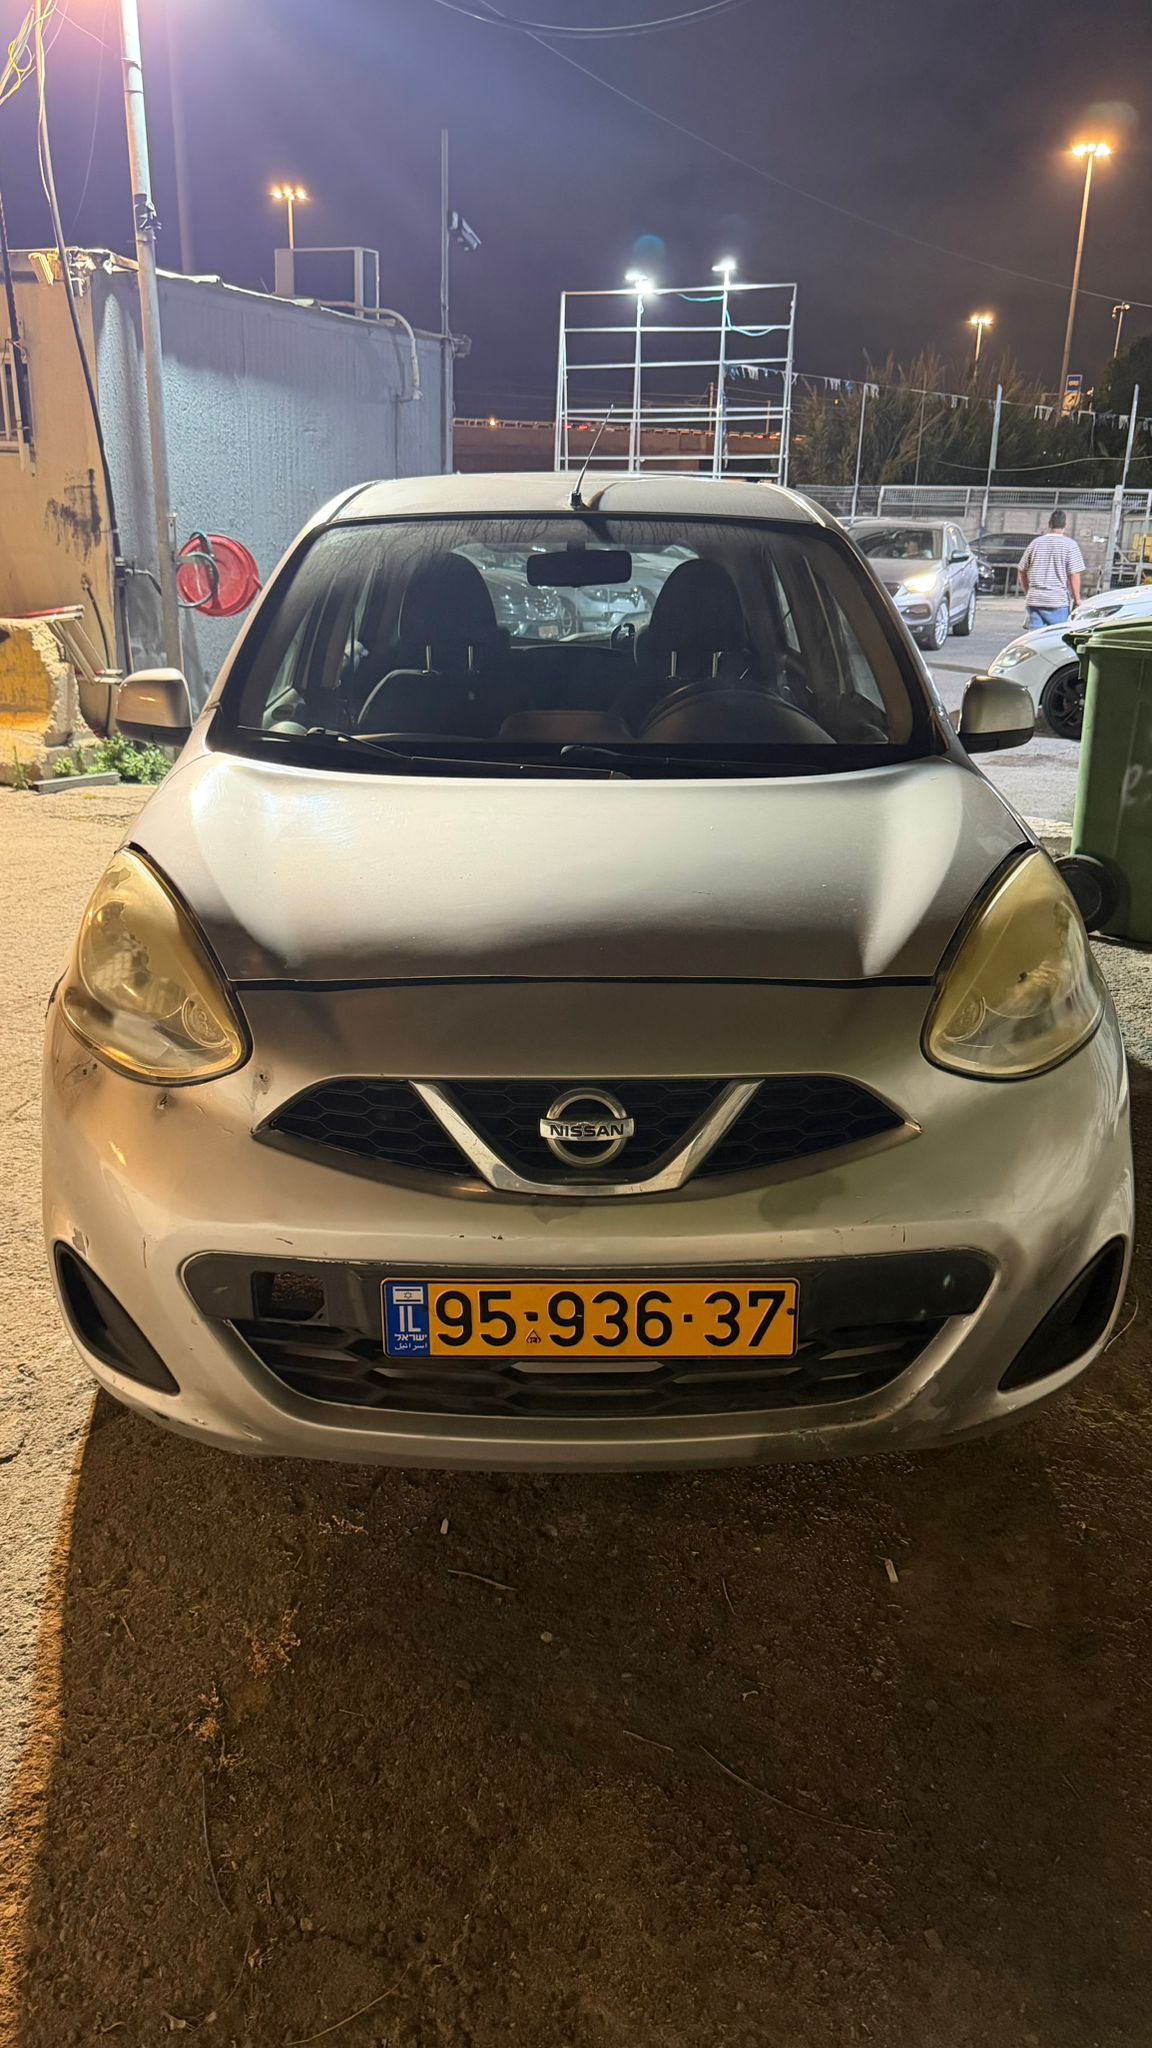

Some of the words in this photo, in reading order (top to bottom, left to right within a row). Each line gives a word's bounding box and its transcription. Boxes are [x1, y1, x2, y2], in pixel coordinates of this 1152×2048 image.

[550, 1124, 624, 1137] NISSAN
[399, 1305, 421, 1332] IL
[394, 1333, 428, 1341] ישראל
